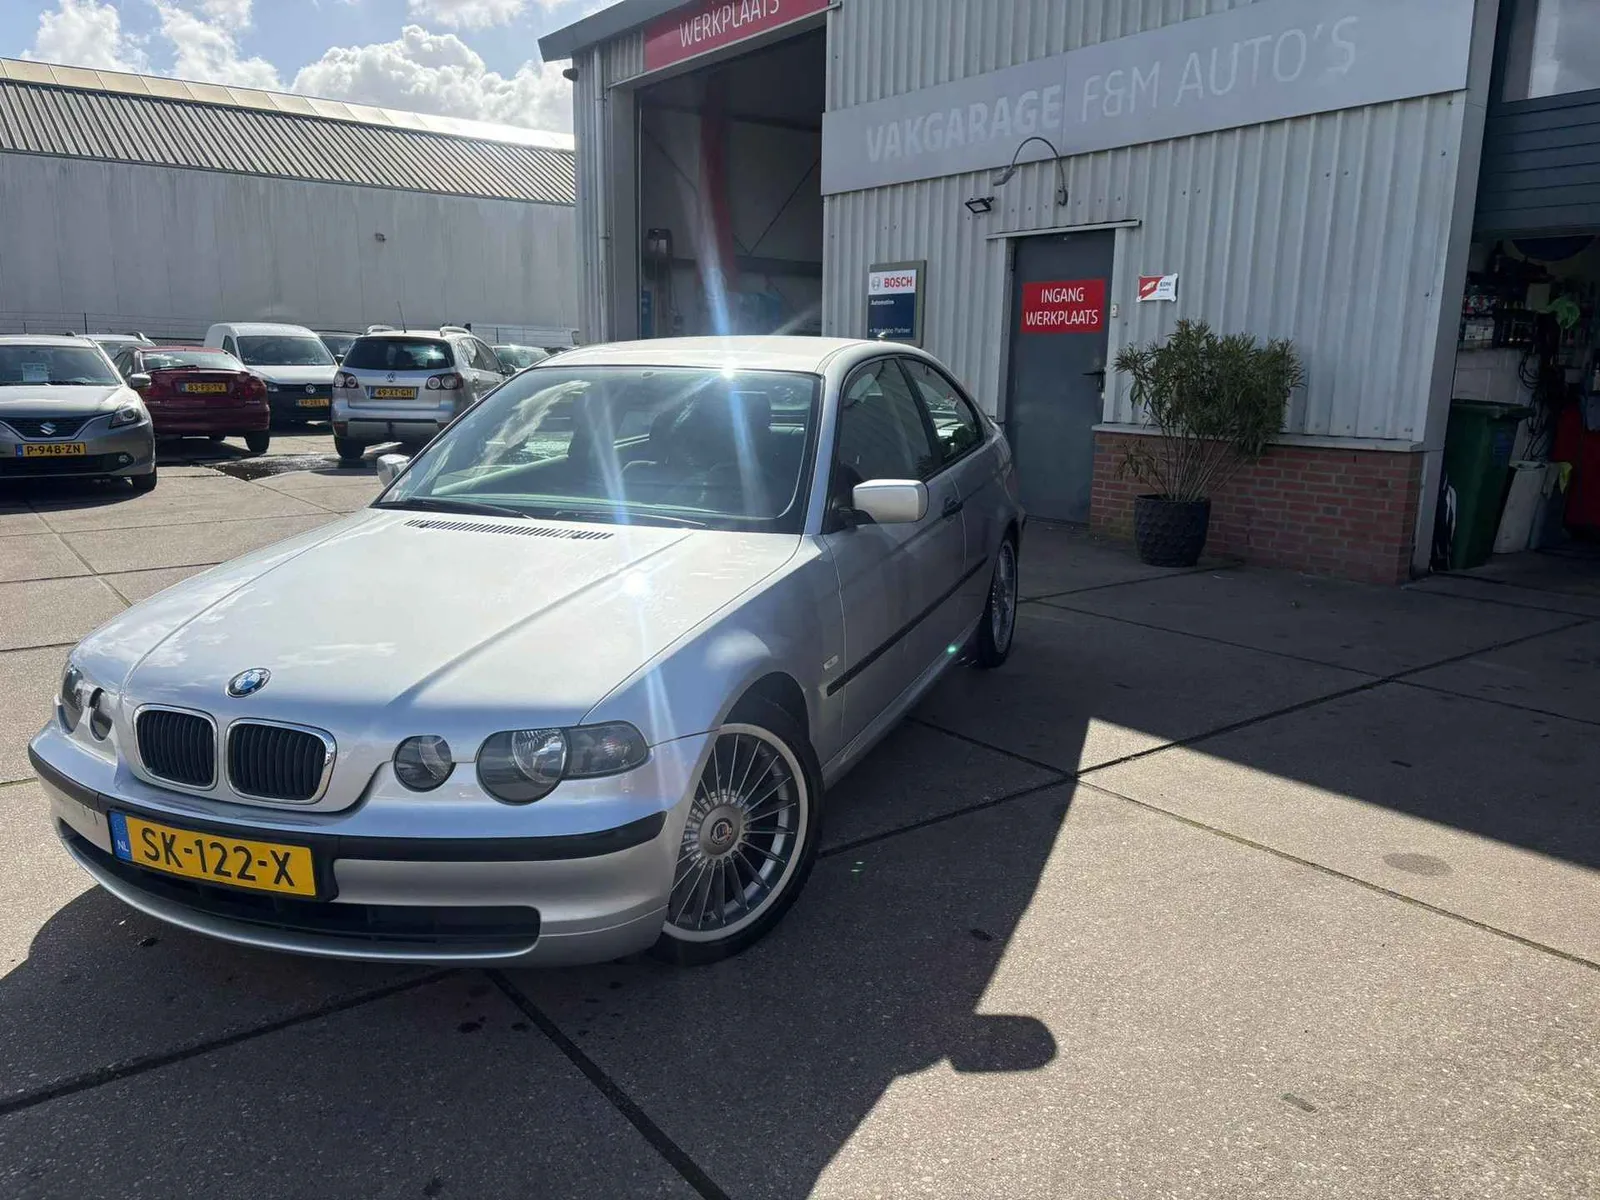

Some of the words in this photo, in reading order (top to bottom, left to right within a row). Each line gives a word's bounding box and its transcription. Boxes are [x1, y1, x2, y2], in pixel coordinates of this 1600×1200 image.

[679, 0, 780, 48] WERKPLAATS
[866, 84, 1061, 163] VAKGARAGE
[1081, 60, 1161, 122] F&M
[1173, 15, 1360, 107] AUTO'S
[884, 276, 913, 288] BOSCH
[1041, 287, 1084, 303] INGANG
[1026, 309, 1098, 326] WERKPLAATS
[26, 444, 81, 455] P-948-ZN
[141, 827, 295, 887] SK-122-X
